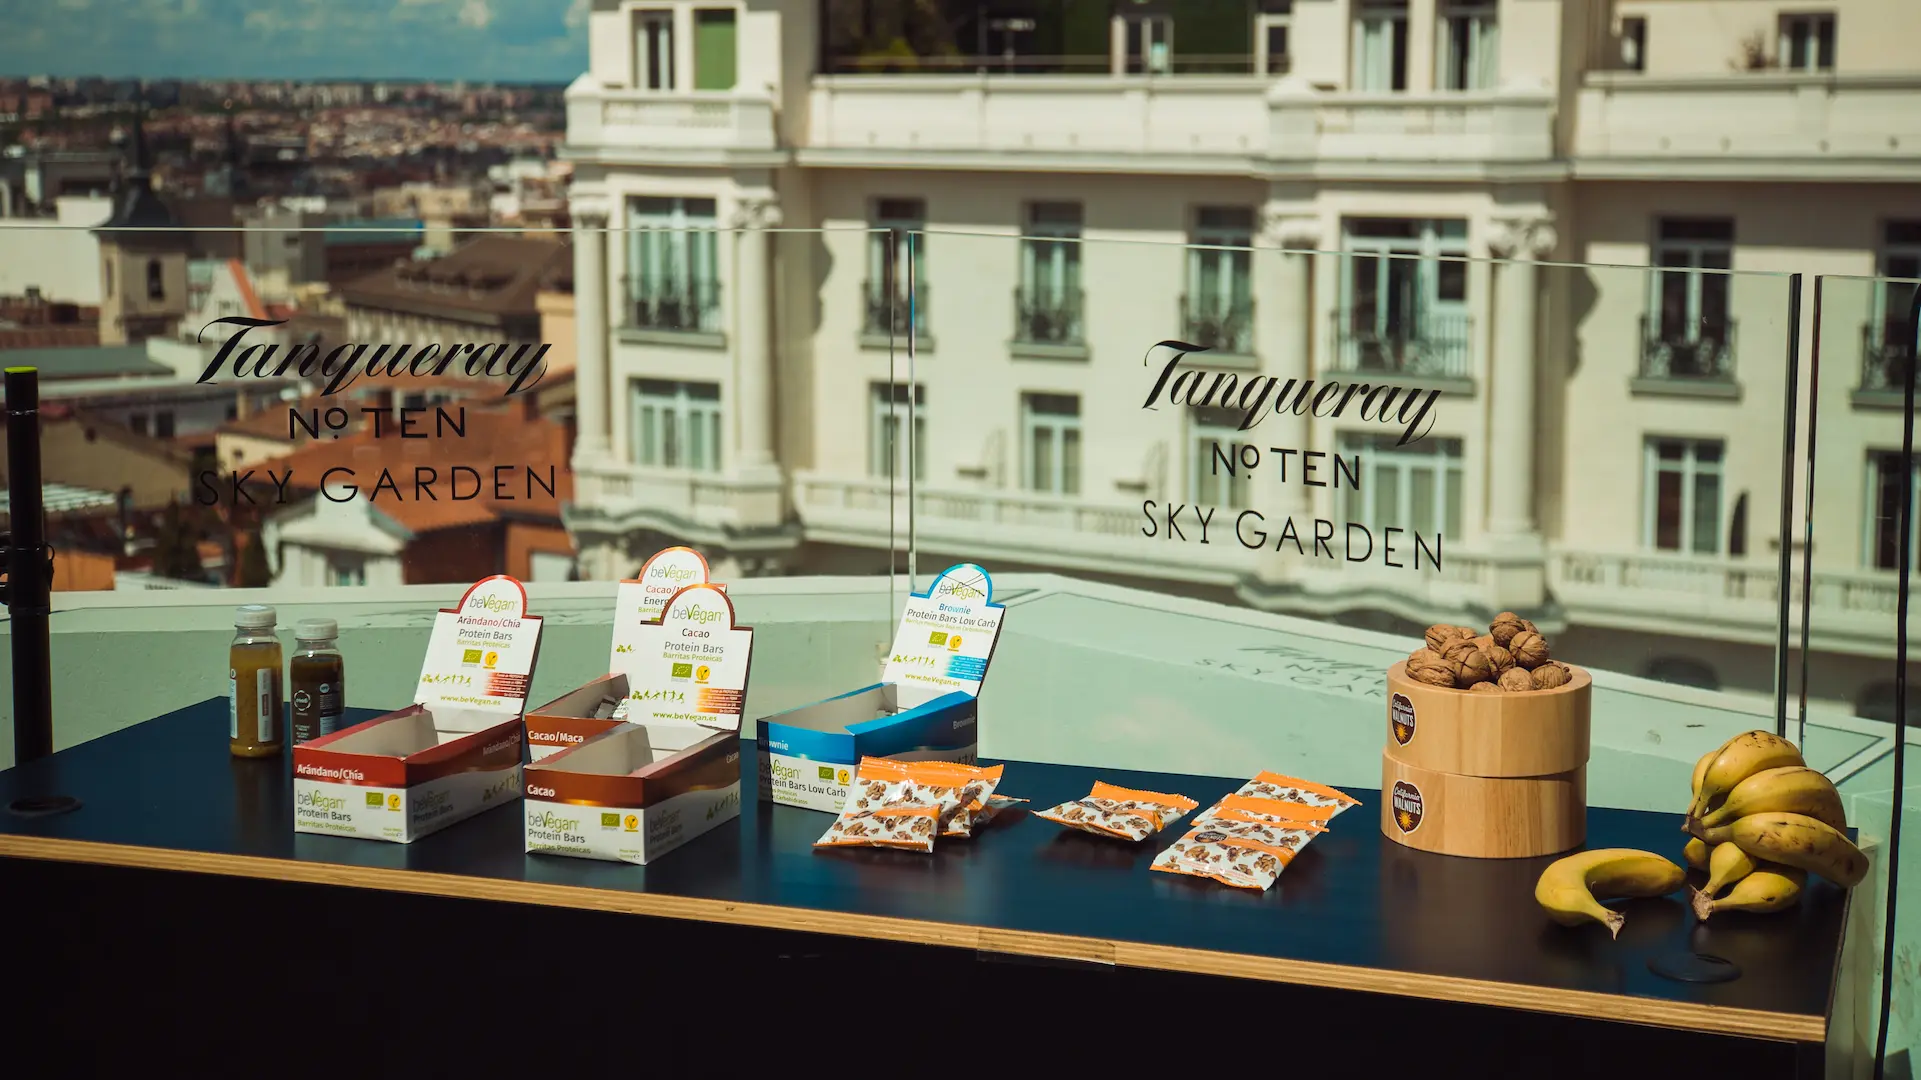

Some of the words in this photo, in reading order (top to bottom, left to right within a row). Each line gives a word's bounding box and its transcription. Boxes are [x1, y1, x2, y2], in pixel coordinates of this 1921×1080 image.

[196, 316, 552, 396] Tanqueray
[1142, 340, 1442, 446] Tanqueray
[361, 407, 466, 438] TEN
[1270, 447, 1360, 490] TEN
[200, 469, 293, 505] SKY
[320, 465, 555, 503] GARDEN
[1142, 500, 1215, 544] SKY
[1236, 510, 1441, 572] GARDEN
[651, 564, 697, 581] beVegan
[469, 594, 516, 613] beVegan
[939, 603, 971, 615] Brownie
[672, 604, 722, 624] beVegan
[907, 608, 937, 621] Protein
[938, 613, 957, 624] Bars
[959, 616, 975, 626] Low
[977, 618, 996, 628] Carb
[459, 628, 491, 640] Protein
[493, 631, 513, 641] Bars
[681, 628, 710, 639] Cacao
[664, 641, 700, 653] Protein
[703, 643, 724, 654] Bars
[663, 652, 690, 661] Barritas
[905, 673, 960, 687] www.beVegan.es
[440, 694, 501, 706] www.beVegan.es
[653, 711, 717, 723] www.beVegan.es
[1392, 709, 1414, 728] WALNUTS
[528, 730, 584, 743] Cacao/Maca
[297, 763, 364, 780] Arándano/Chía
[526, 784, 556, 798] Cacao
[789, 780, 807, 792] Bars
[808, 783, 825, 794] Low
[826, 787, 847, 798] Carb
[297, 789, 344, 811] beVegan
[1394, 796, 1421, 815] WALNUTS
[297, 806, 329, 819] Protein
[331, 811, 352, 822] Bars
[528, 811, 577, 833] beVegan
[528, 828, 561, 841] Protein
[563, 832, 586, 844] Bars
